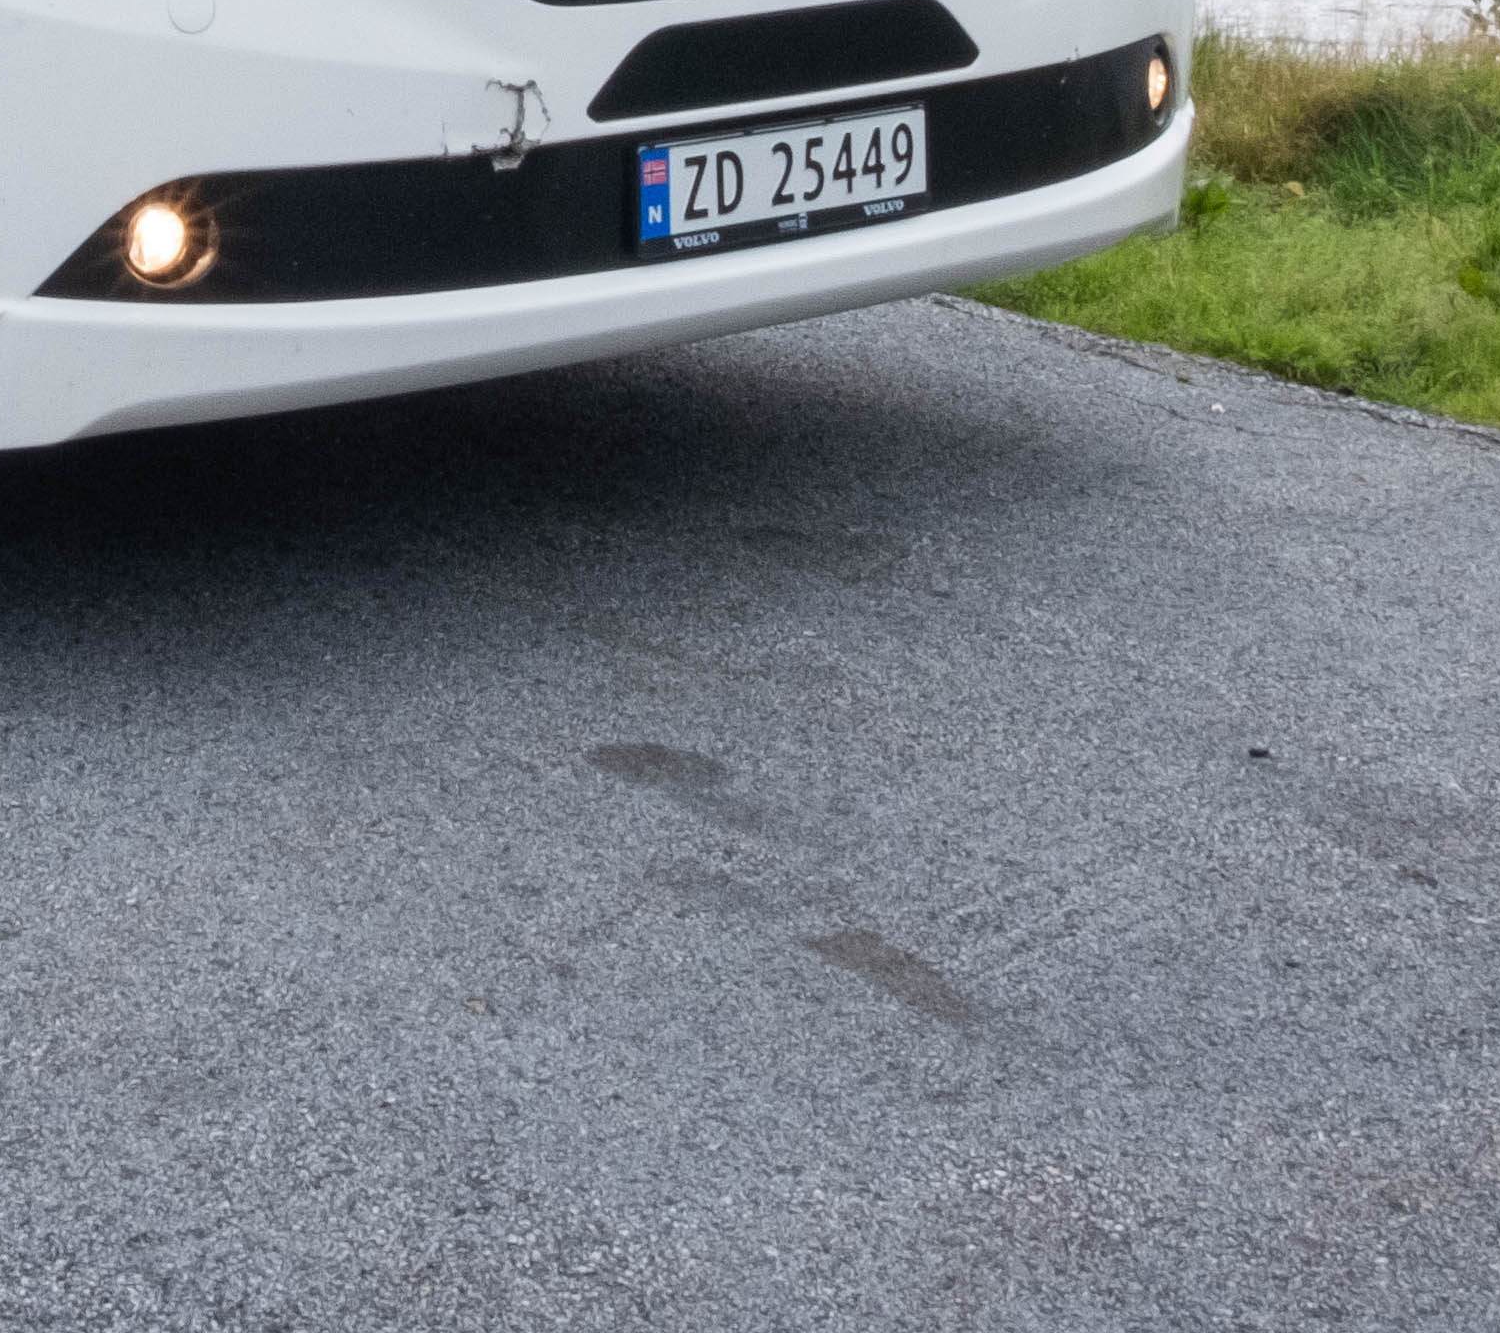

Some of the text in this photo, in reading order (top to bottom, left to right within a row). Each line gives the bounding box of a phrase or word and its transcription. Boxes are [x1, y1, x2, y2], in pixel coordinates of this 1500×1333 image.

[684, 122, 914, 221] ZD 25449
[647, 204, 663, 224] N
[863, 198, 905, 217] VOLVO
[673, 230, 720, 250] VOLVO
